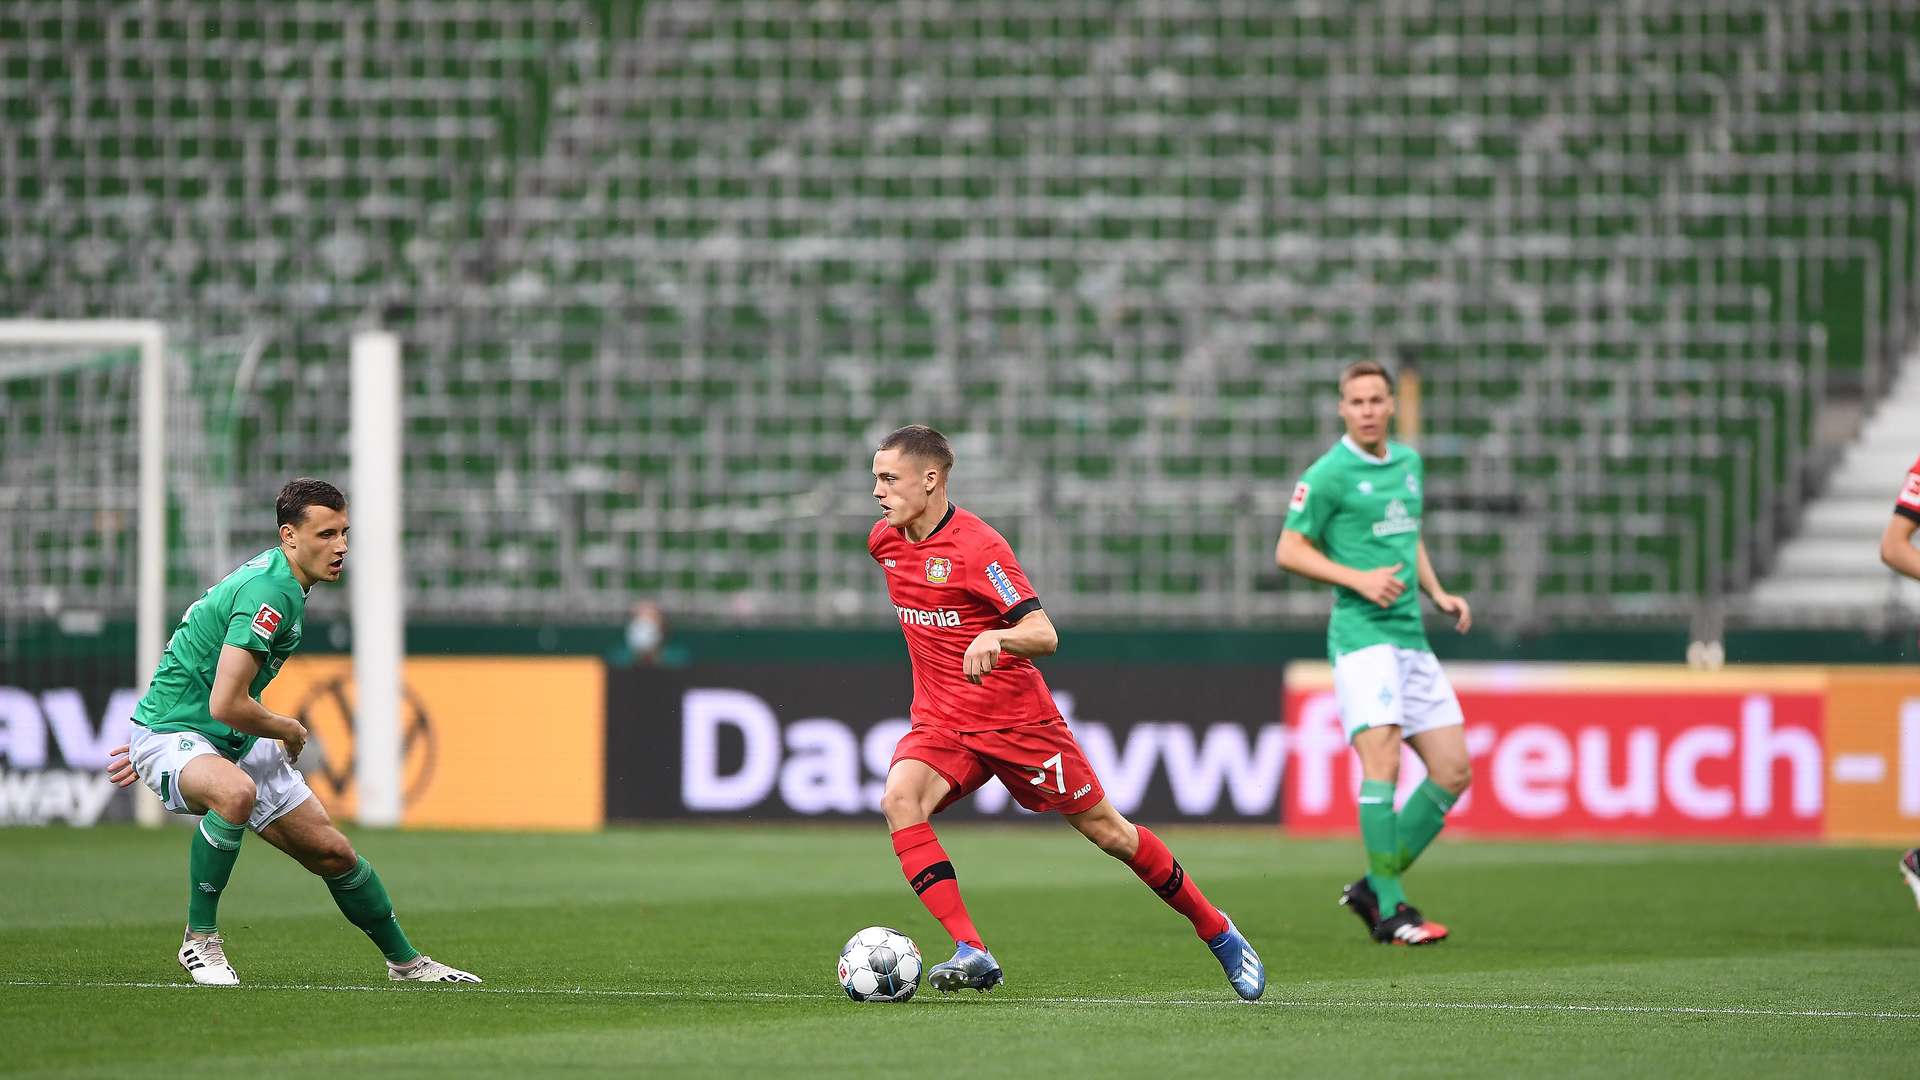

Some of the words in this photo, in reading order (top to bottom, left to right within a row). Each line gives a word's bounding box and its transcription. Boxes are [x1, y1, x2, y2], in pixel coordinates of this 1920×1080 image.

[985, 566, 1012, 607] TRAINING
[991, 560, 1021, 601] KIESER
[894, 604, 961, 627] rmenia
[1073, 783, 1092, 800] JAKO
